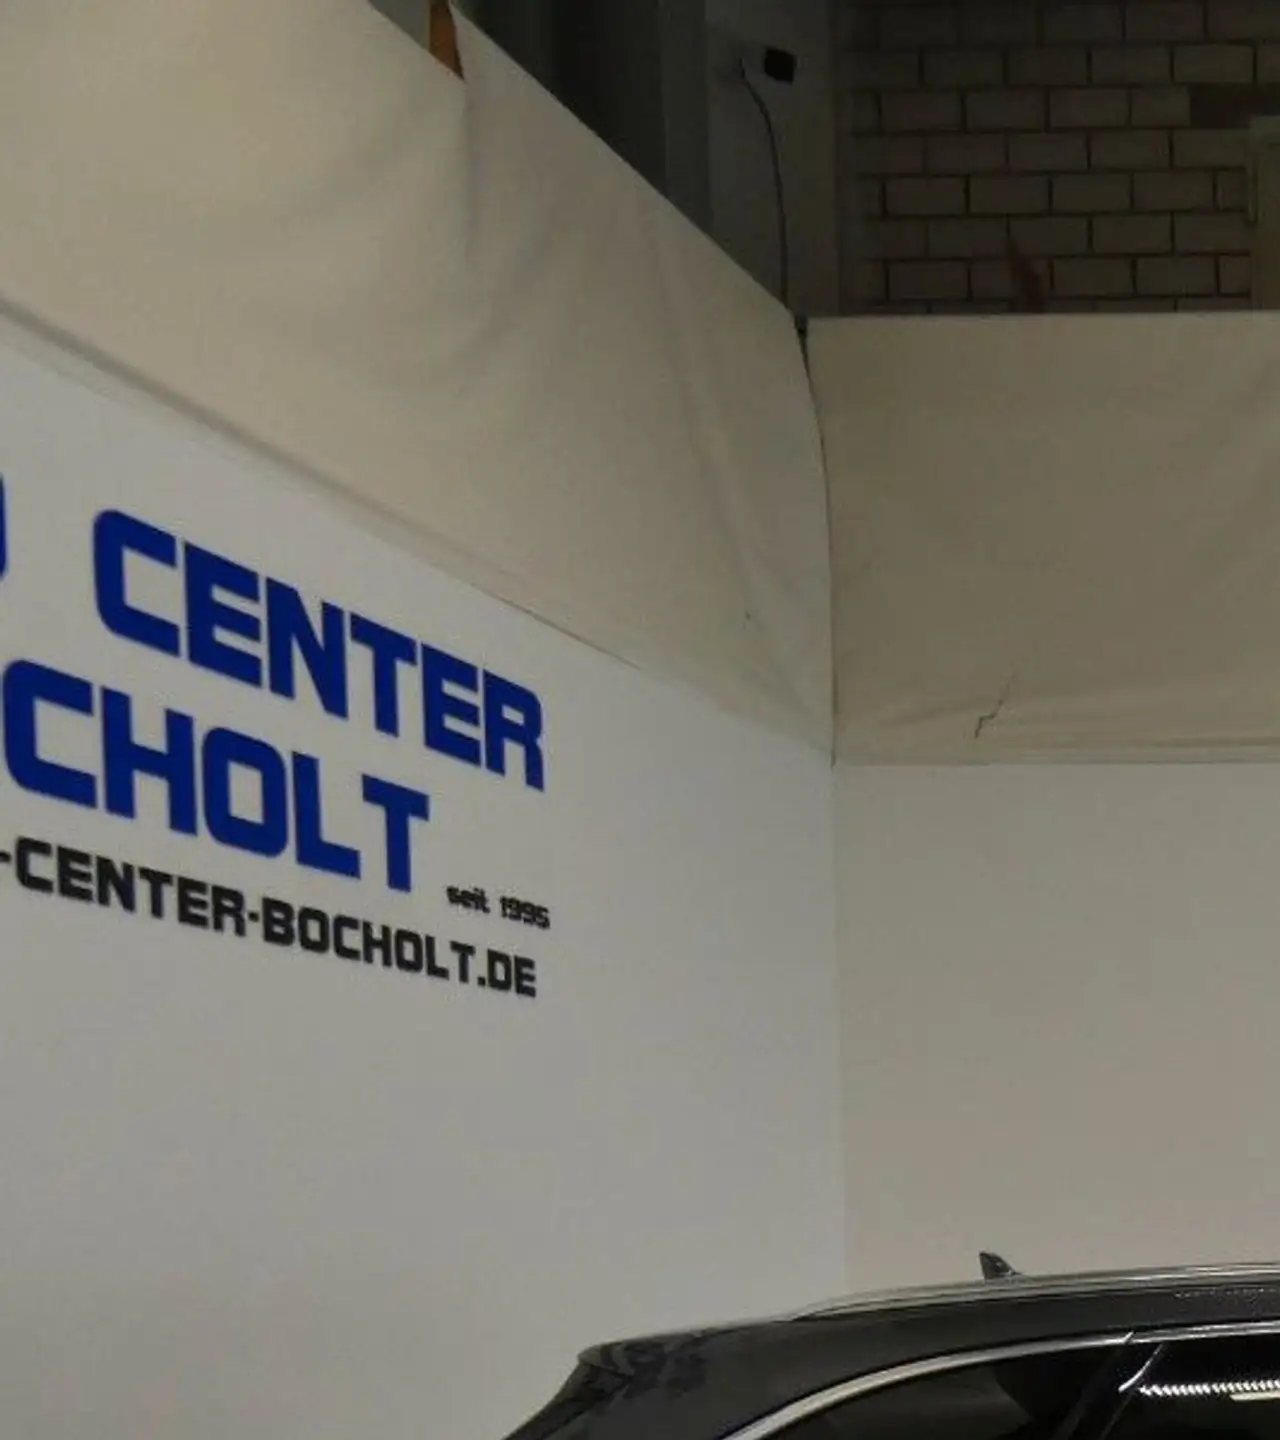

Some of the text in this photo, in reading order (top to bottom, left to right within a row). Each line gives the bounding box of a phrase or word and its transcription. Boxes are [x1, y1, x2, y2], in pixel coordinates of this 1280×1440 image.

[93, 510, 545, 790] CENTER
[445, 885, 491, 914] seit
[499, 895, 551, 930] 1995
